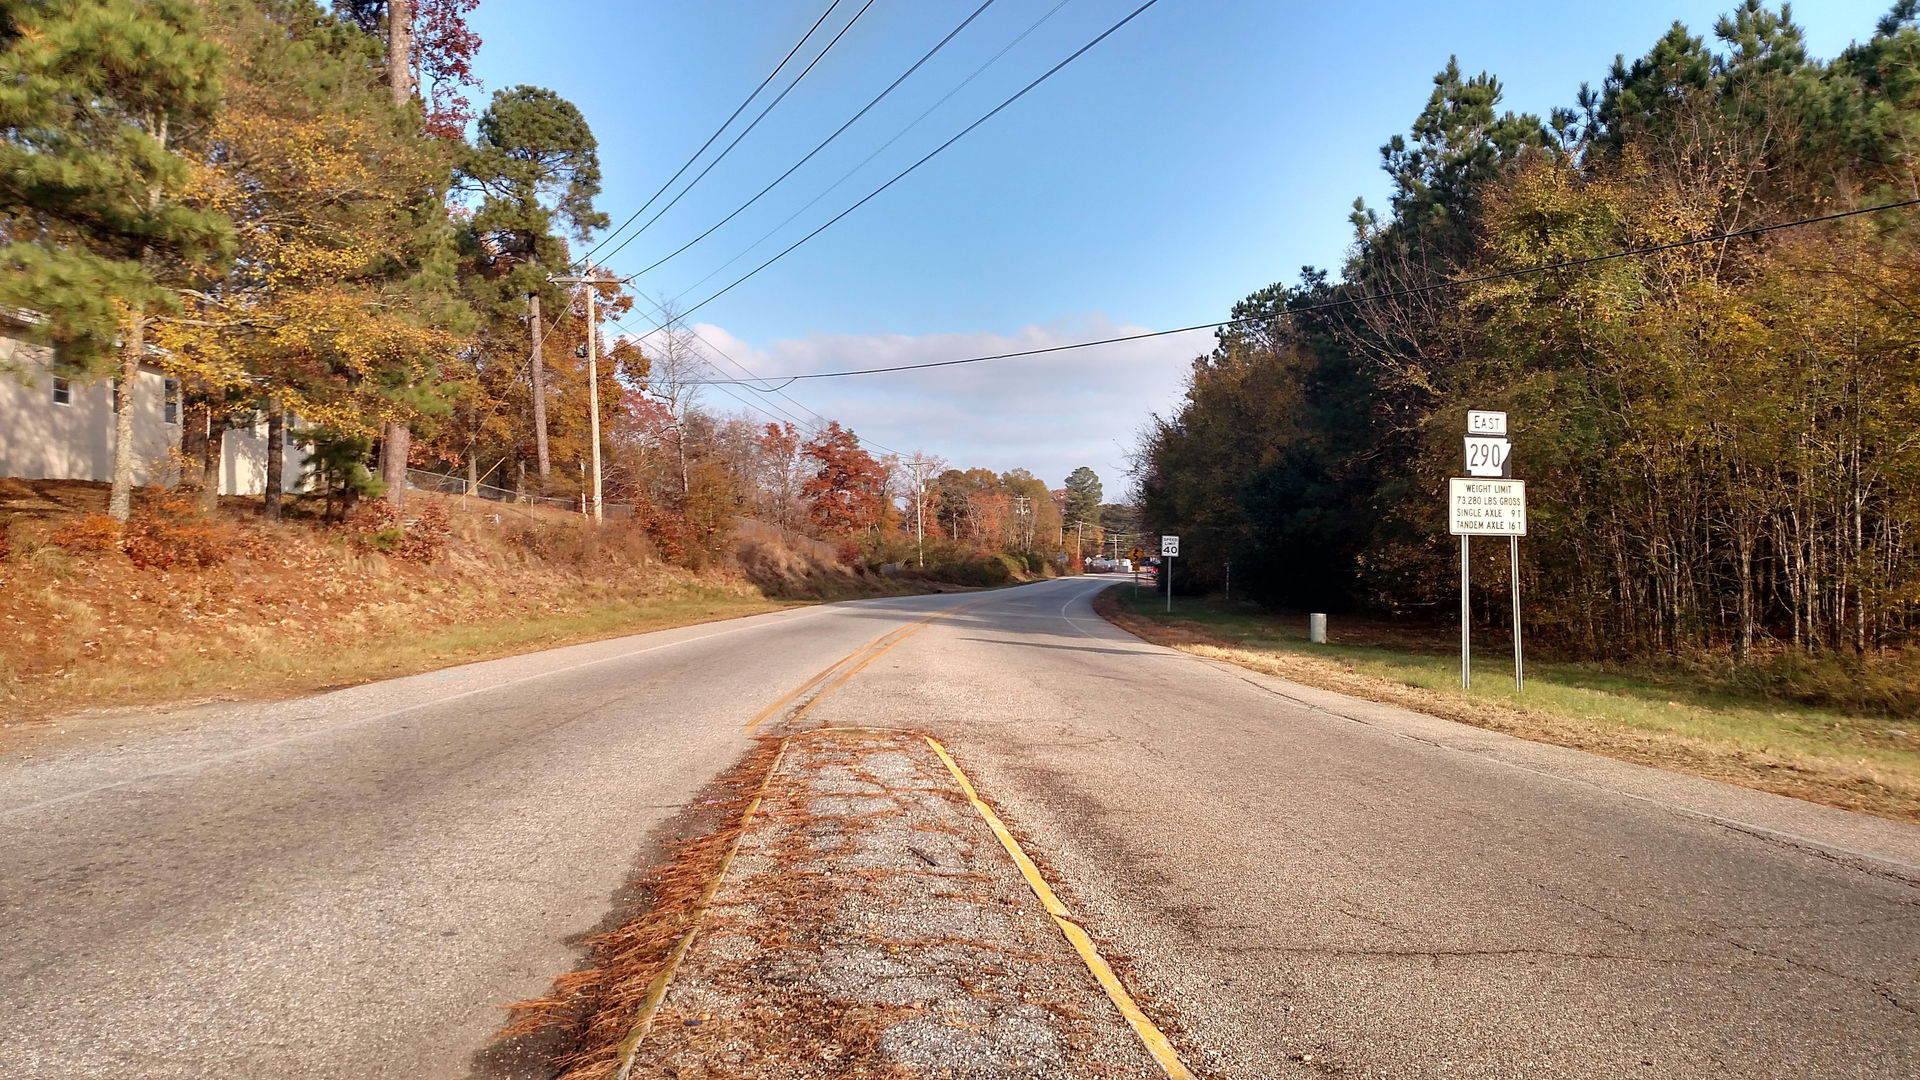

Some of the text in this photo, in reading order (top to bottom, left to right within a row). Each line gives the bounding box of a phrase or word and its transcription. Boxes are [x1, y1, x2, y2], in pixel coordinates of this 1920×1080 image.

[1474, 415, 1500, 430] EAST
[1470, 443, 1500, 468] 290
[1466, 484, 1511, 494] WEIGHT LIMIT
[1500, 497, 1520, 506] GROSS
[1456, 508, 1481, 517] SINGLE
[1485, 509, 1502, 517] AXLE
[1511, 509, 1515, 517] 9
[1456, 520, 1484, 529] TANDEM
[1486, 521, 1504, 530] AXLE
[1508, 521, 1515, 530] 16
[1163, 546, 1177, 554] 40
